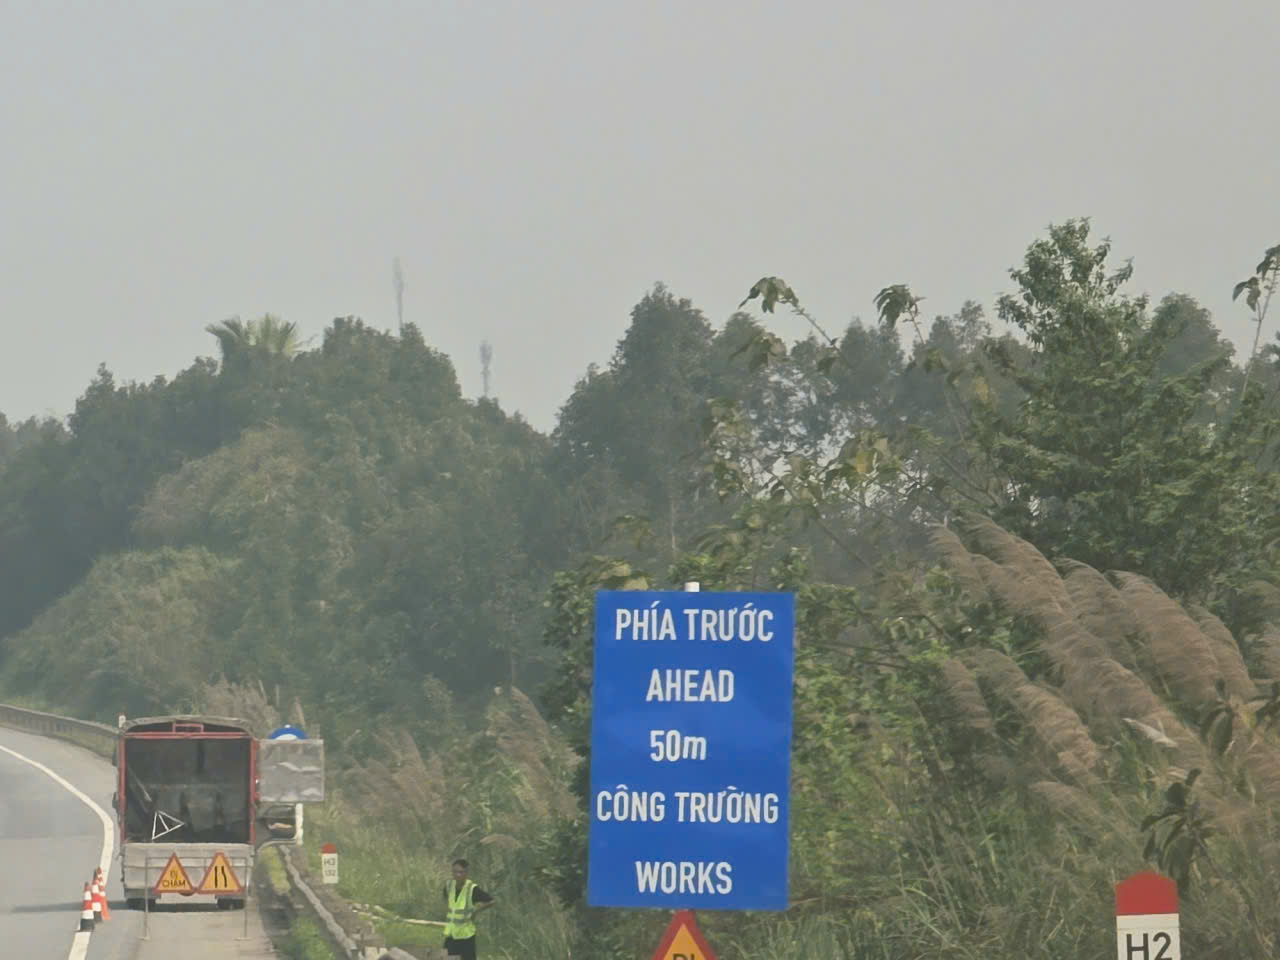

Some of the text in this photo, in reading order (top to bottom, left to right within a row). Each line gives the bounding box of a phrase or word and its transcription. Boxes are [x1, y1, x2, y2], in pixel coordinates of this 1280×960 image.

[615, 600, 774, 642] PHÍA TRƯỚC
[645, 668, 735, 703] AHEAD
[650, 729, 707, 762] 50m
[596, 784, 780, 824] CÔNG TRƯỜNG
[635, 860, 733, 895] WORKS
